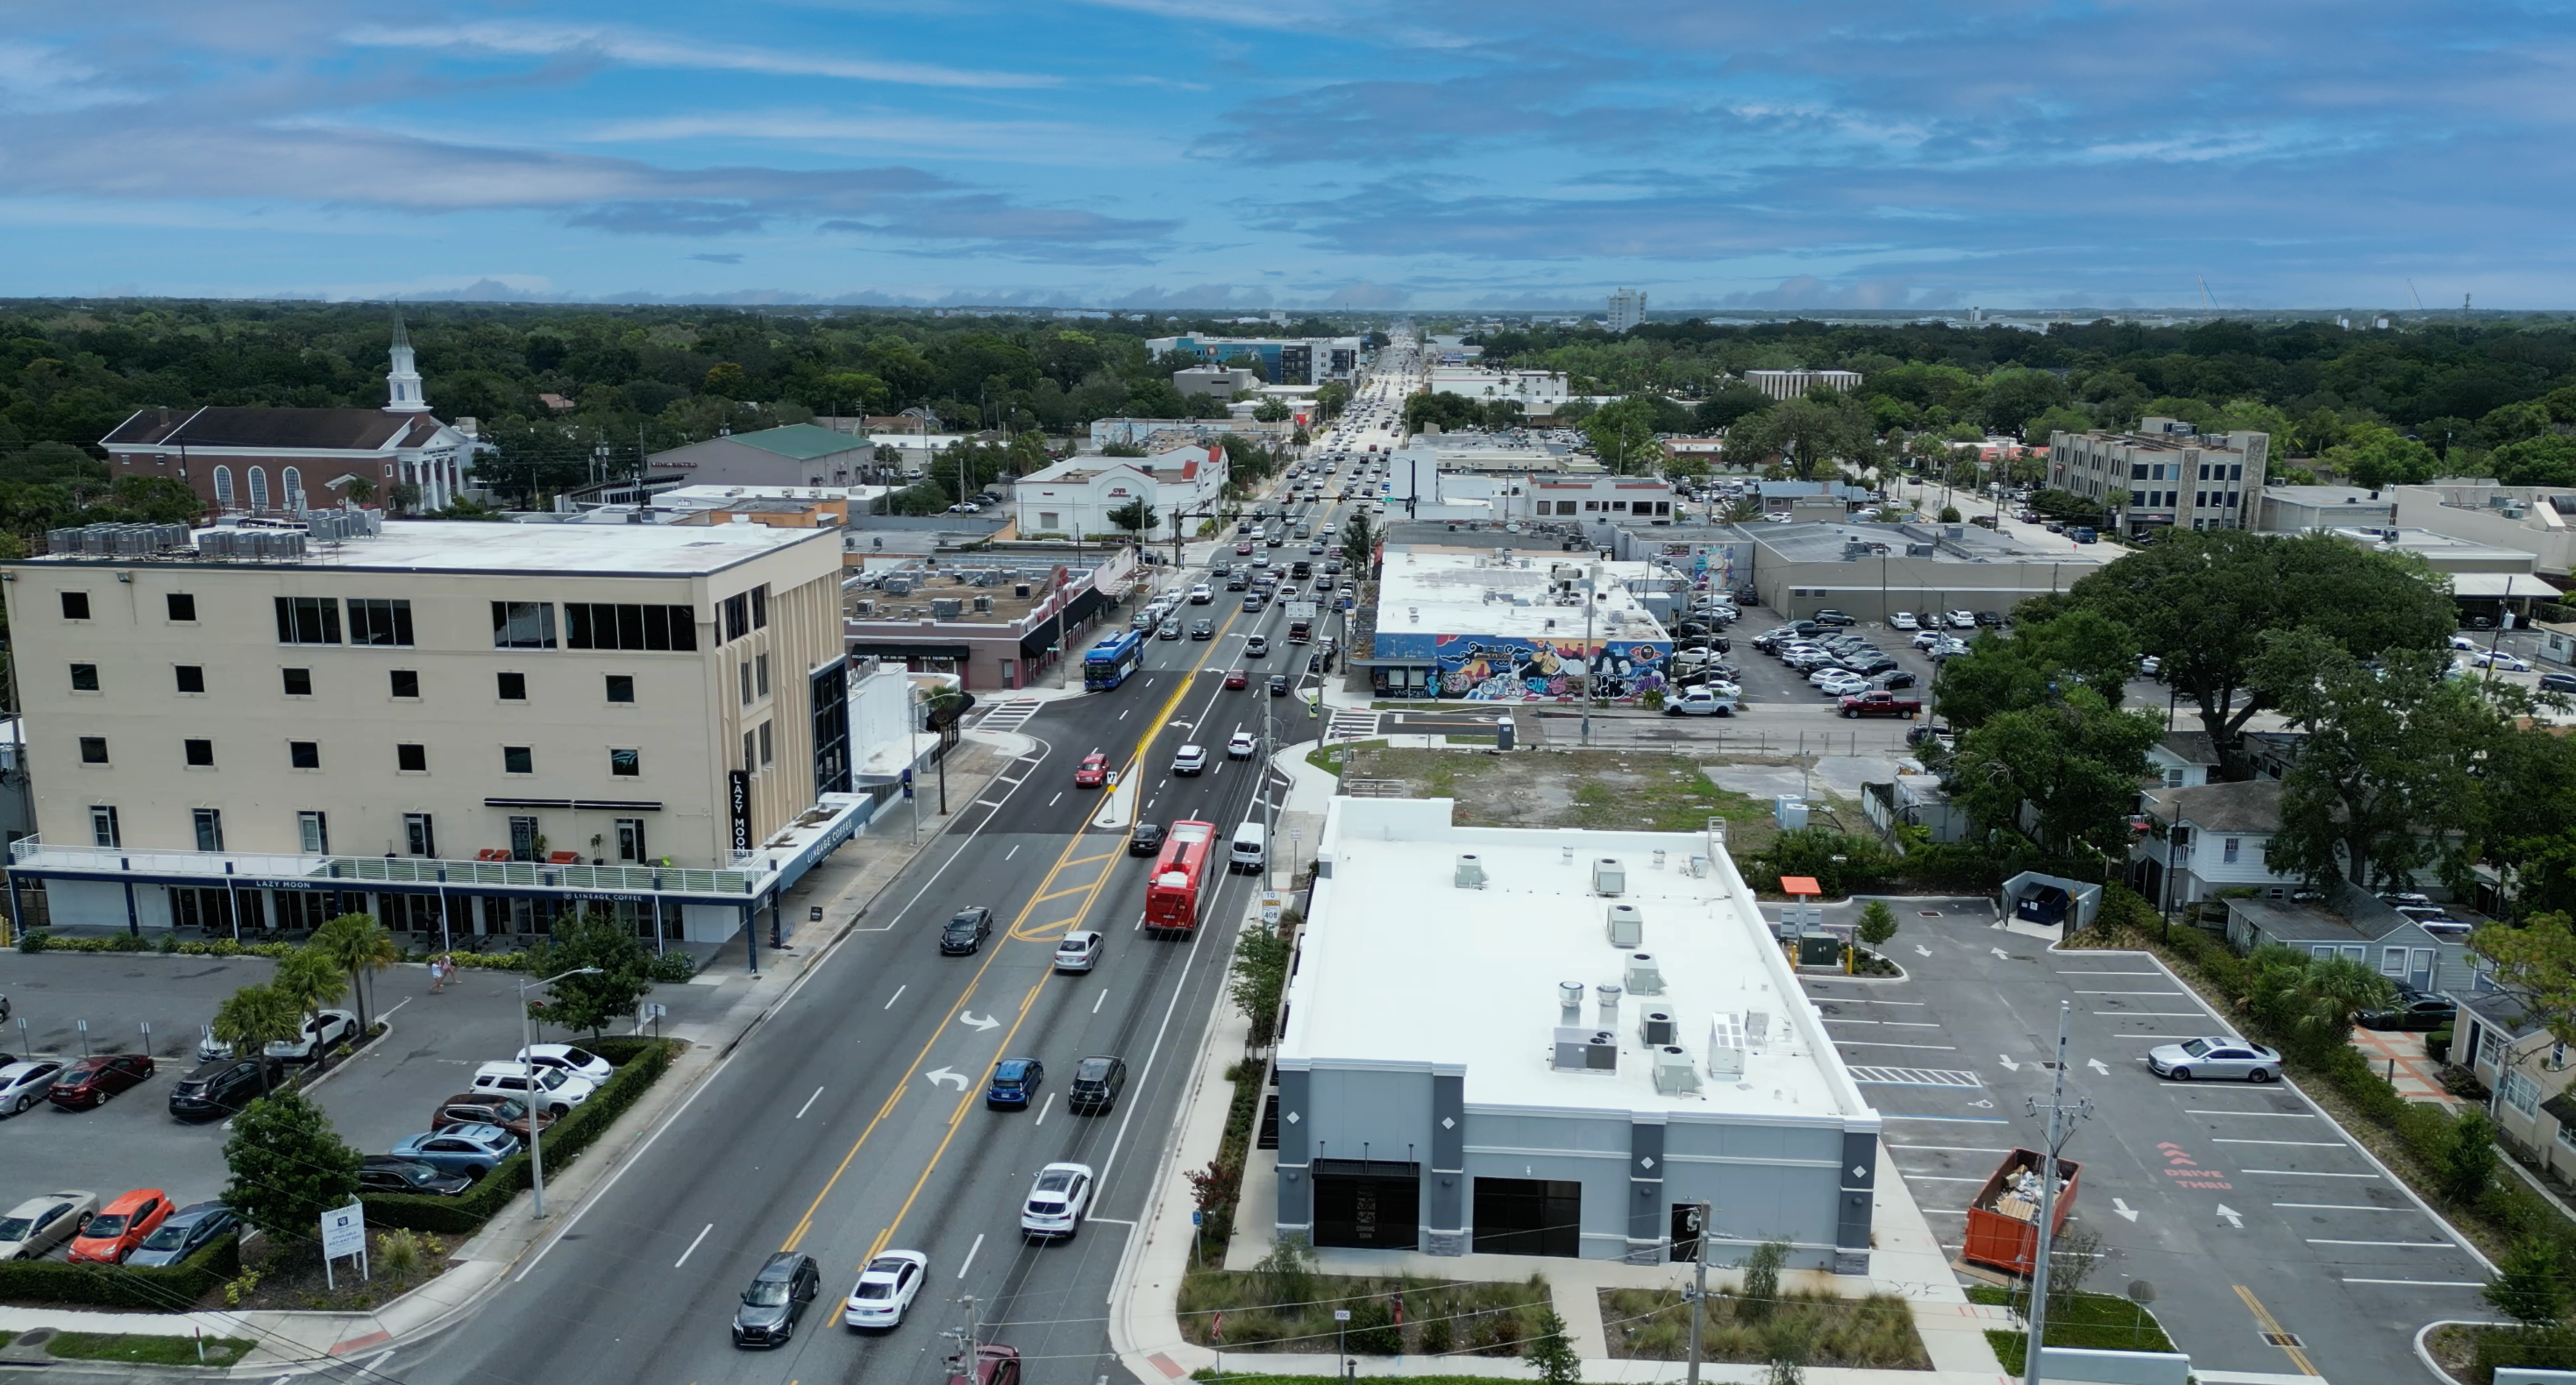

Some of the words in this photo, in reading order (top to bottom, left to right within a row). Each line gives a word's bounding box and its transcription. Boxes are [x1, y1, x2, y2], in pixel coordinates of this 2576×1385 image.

[734, 774, 743, 813] LAZY
[807, 836, 831, 863] LINEAGE
[832, 818, 852, 842] COFFEE
[2163, 1168, 2224, 1178] DRIVE
[2174, 1180, 2232, 1190] THRU
[339, 1206, 357, 1215] LEASE
